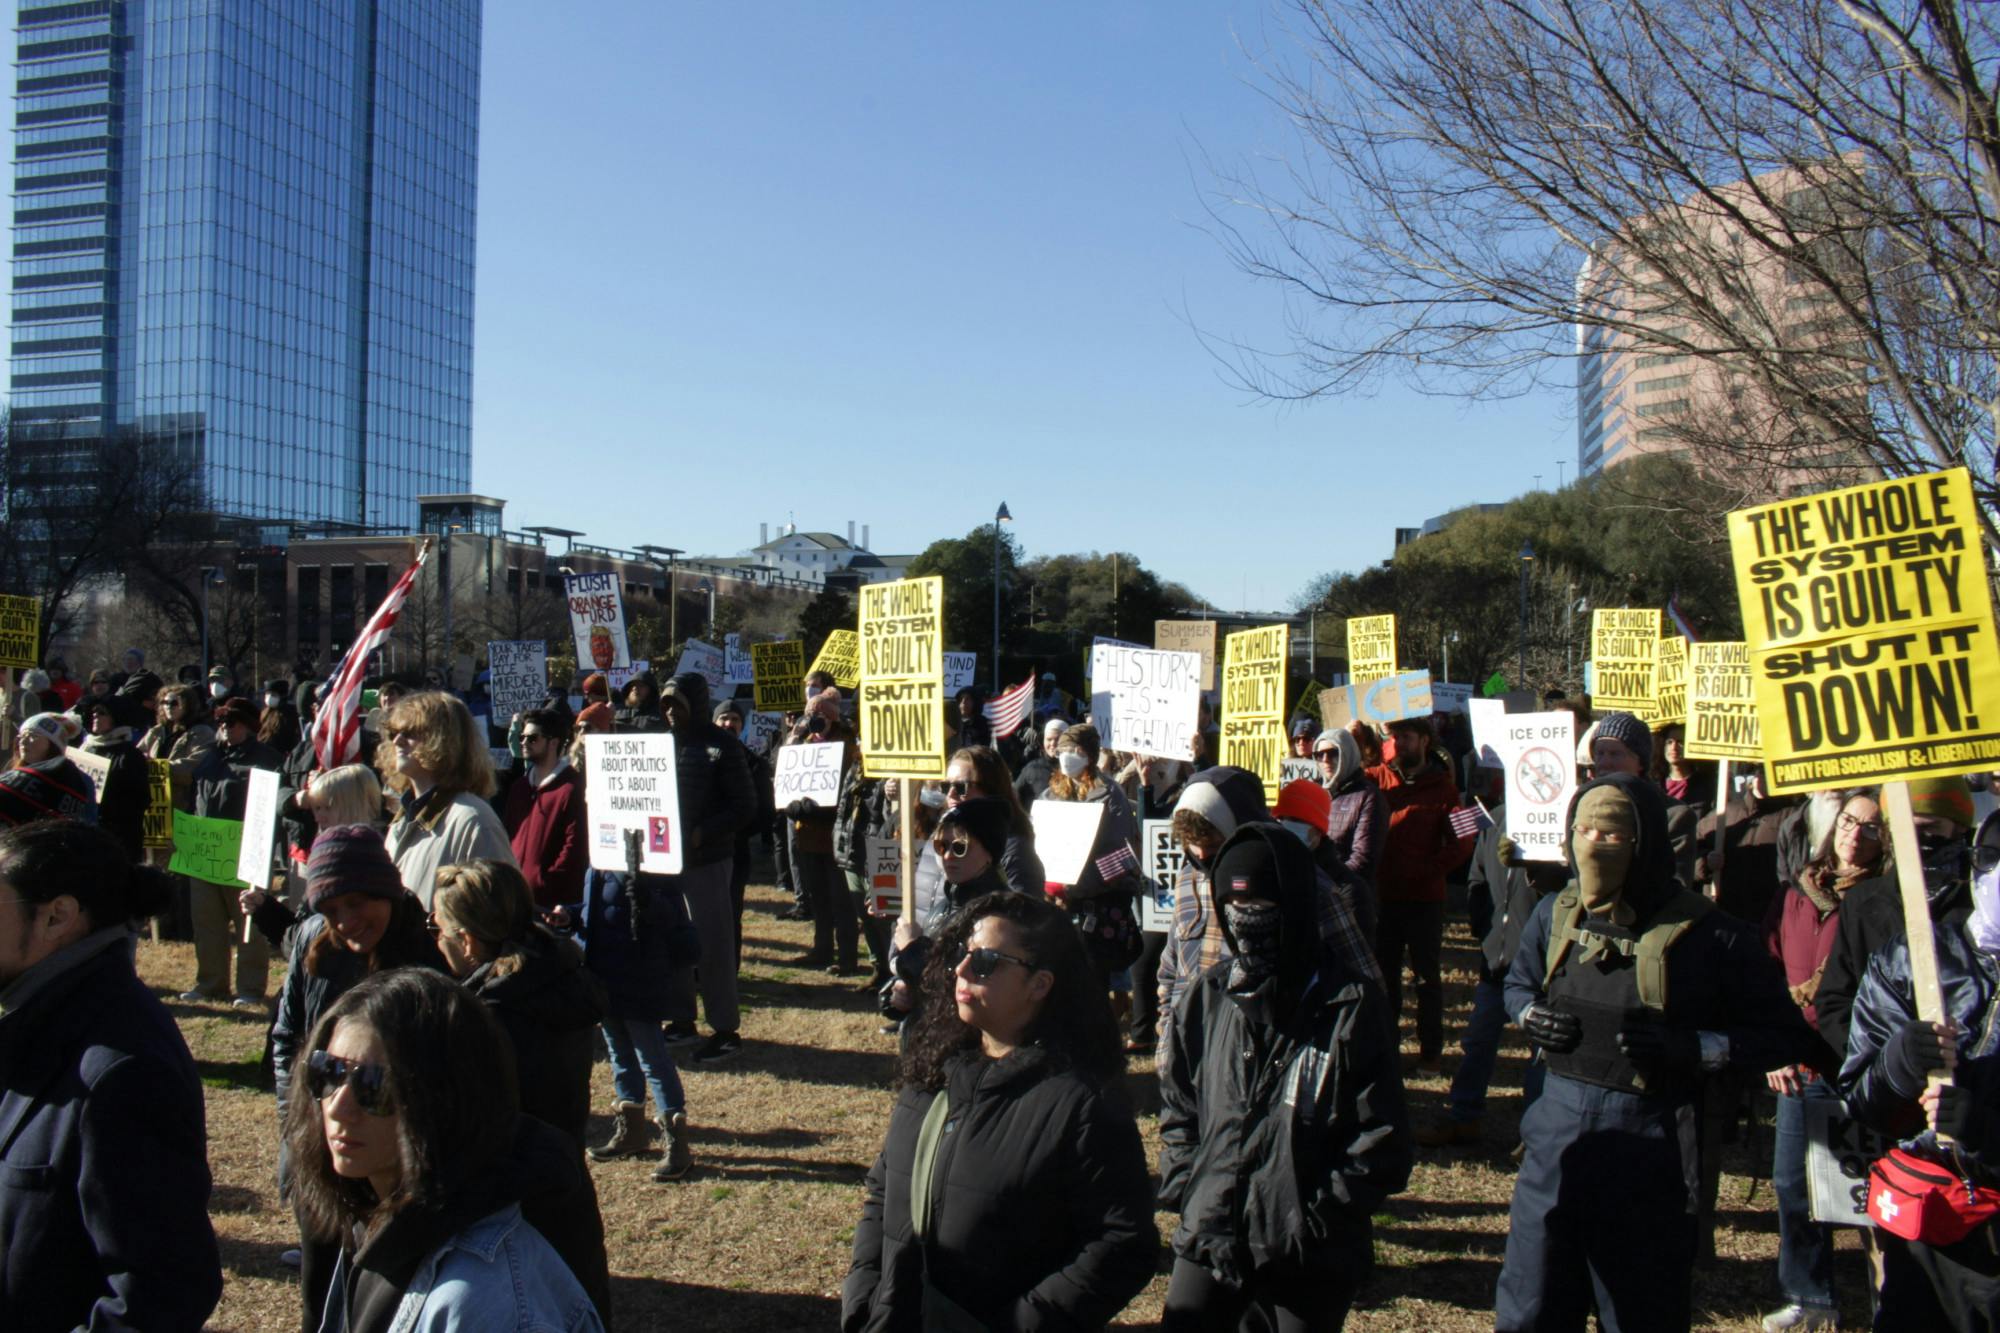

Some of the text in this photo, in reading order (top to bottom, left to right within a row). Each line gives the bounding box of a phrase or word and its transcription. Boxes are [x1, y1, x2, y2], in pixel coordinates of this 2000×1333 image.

[1747, 477, 1955, 558] THE WHOLE
[1750, 527, 1966, 584] SYSTEM
[567, 573, 611, 593] FLUSH
[568, 594, 617, 614] ORANGE
[866, 581, 934, 618] THE WHOLE
[1761, 555, 1962, 641] IS GUILTY
[2, 615, 35, 632] GUILTY
[578, 608, 616, 624] TURD
[1599, 612, 1655, 628] THE WHOLE
[864, 616, 935, 637] SYSTEM
[1160, 623, 1212, 638] SUMMER
[1351, 617, 1390, 634] THE WHOLE
[1597, 629, 1656, 637] SYSTEM
[1180, 638, 1190, 647] IS
[1231, 636, 1244, 664] THE
[1245, 630, 1282, 660] WHOLE
[1351, 633, 1391, 643] SYSTEM
[493, 643, 543, 653] YOUR TAXES
[755, 642, 799, 656] THE WHOLE
[826, 644, 859, 658] IS GUIL
[866, 634, 934, 675] IS GUILTY
[1352, 641, 1390, 660] IS GUILTY
[1597, 638, 1654, 658] IS GUILTY
[1697, 645, 1718, 663] THE
[1764, 624, 1980, 680] SHUT IT
[494, 653, 532, 664] PAY FOR
[755, 654, 800, 663] SYSTEM
[1352, 662, 1392, 671] SHUT IT
[1596, 661, 1655, 671] SHUT IT
[494, 663, 518, 676] ICE
[757, 662, 800, 677] IS GUILTY
[1107, 649, 1193, 693] HISTORY
[1227, 661, 1281, 679] SYSTEM
[1694, 664, 1752, 674] SYSTE
[758, 678, 790, 686] SHUT
[1599, 672, 1650, 697] DOWN!
[1674, 684, 1687, 693] IT
[1696, 676, 1709, 697] IS
[761, 685, 801, 703] DOWN!
[864, 683, 936, 702] SHUT IT
[1125, 685, 1151, 714] IS
[1228, 682, 1236, 713] IS
[1238, 677, 1279, 713] GUILTY
[1345, 668, 1433, 721] ICE
[1694, 701, 1746, 712] SHUT
[1783, 657, 1982, 753] DOWN!
[870, 703, 932, 751] DOWN!
[1098, 716, 1187, 755] WATCHING
[1225, 720, 1280, 736] SHUT IT
[1510, 726, 1568, 740] ICE OFF
[1697, 713, 1760, 745] DOWN!
[603, 741, 621, 755] THIS
[601, 758, 667, 772] ABOUT POLITICS
[784, 746, 832, 770] DUE
[1227, 739, 1275, 781] DOWN!
[1775, 766, 1814, 783] PARTY
[1815, 758, 1841, 777] FOR
[1841, 750, 1909, 775] SOCIALISM
[1909, 749, 1928, 766] &
[628, 777, 656, 791] ABOUT
[776, 769, 839, 794] PROCESS
[610, 796, 662, 812] HUMANITY!!
[1526, 812, 1558, 824] OUR
[878, 863, 900, 873] MY
